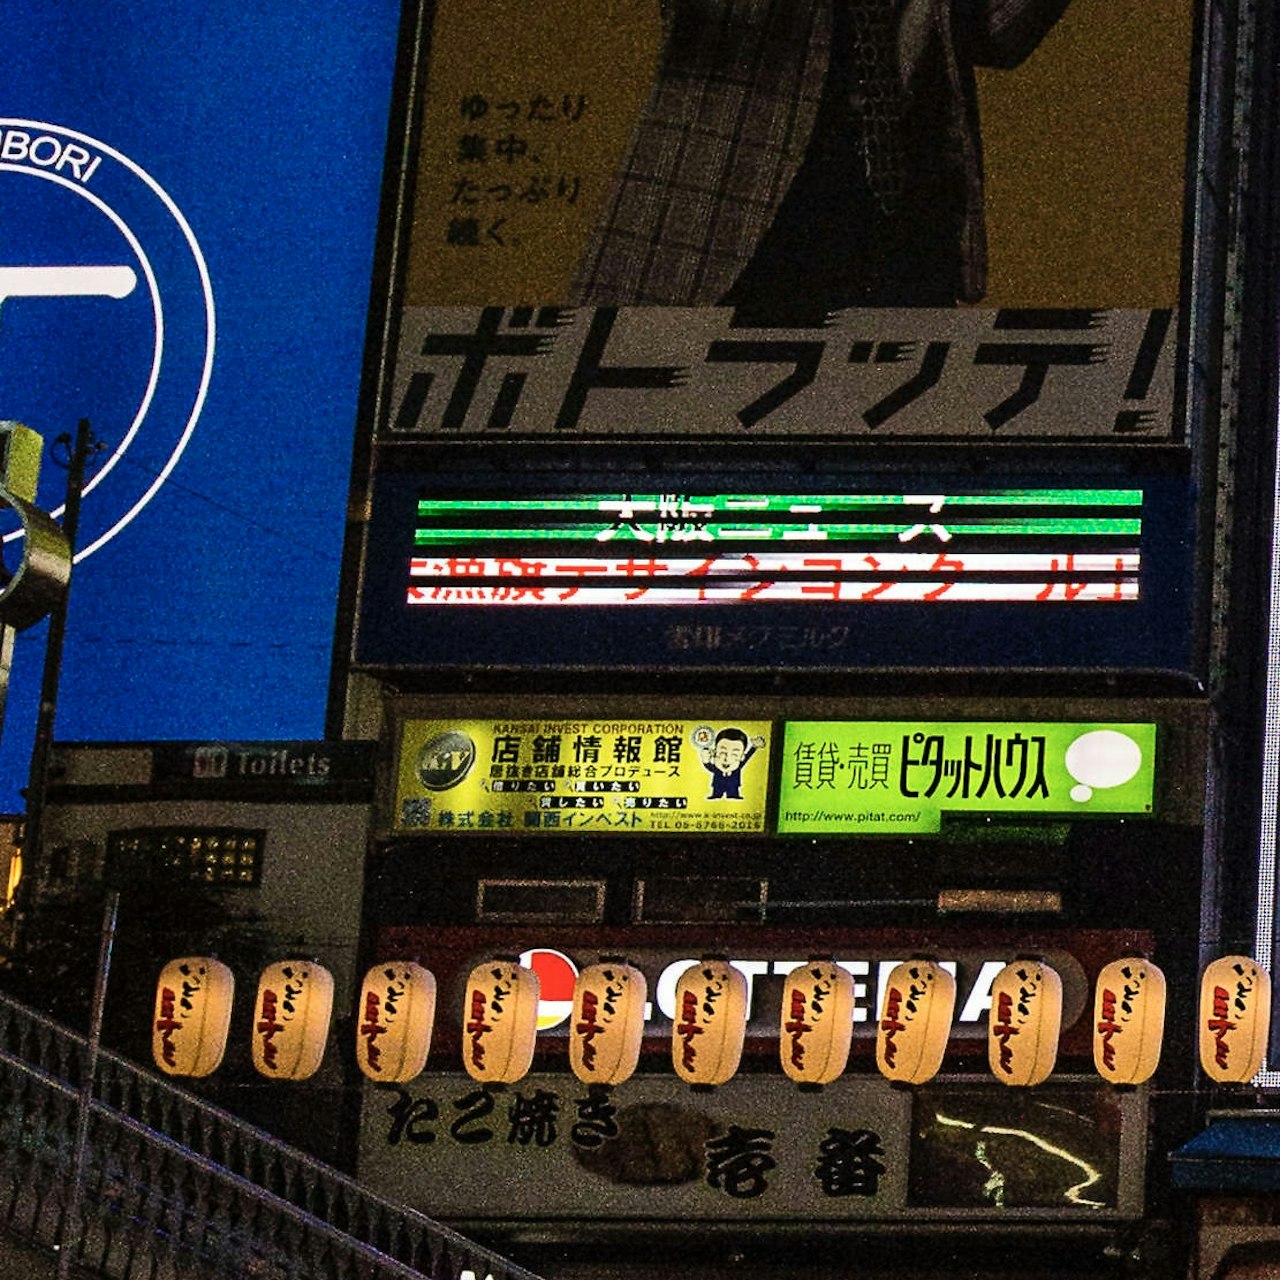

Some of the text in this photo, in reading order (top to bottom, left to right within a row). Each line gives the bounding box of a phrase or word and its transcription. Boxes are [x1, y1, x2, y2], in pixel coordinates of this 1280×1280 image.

[460, 93, 585, 121] ゆったり
[493, 723, 684, 734] KANSAI INVEST CORPORATION
[238, 749, 332, 777] Toilets
[491, 734, 683, 764] 店舗情報館
[900, 732, 1051, 800] ピタットハウス
[438, 811, 643, 829] 株式会社 関西インベスト
[650, 821, 670, 830] TEL
[784, 810, 922, 824] http://www.pitat.com/
[385, 1090, 620, 1148] たこ焼き
